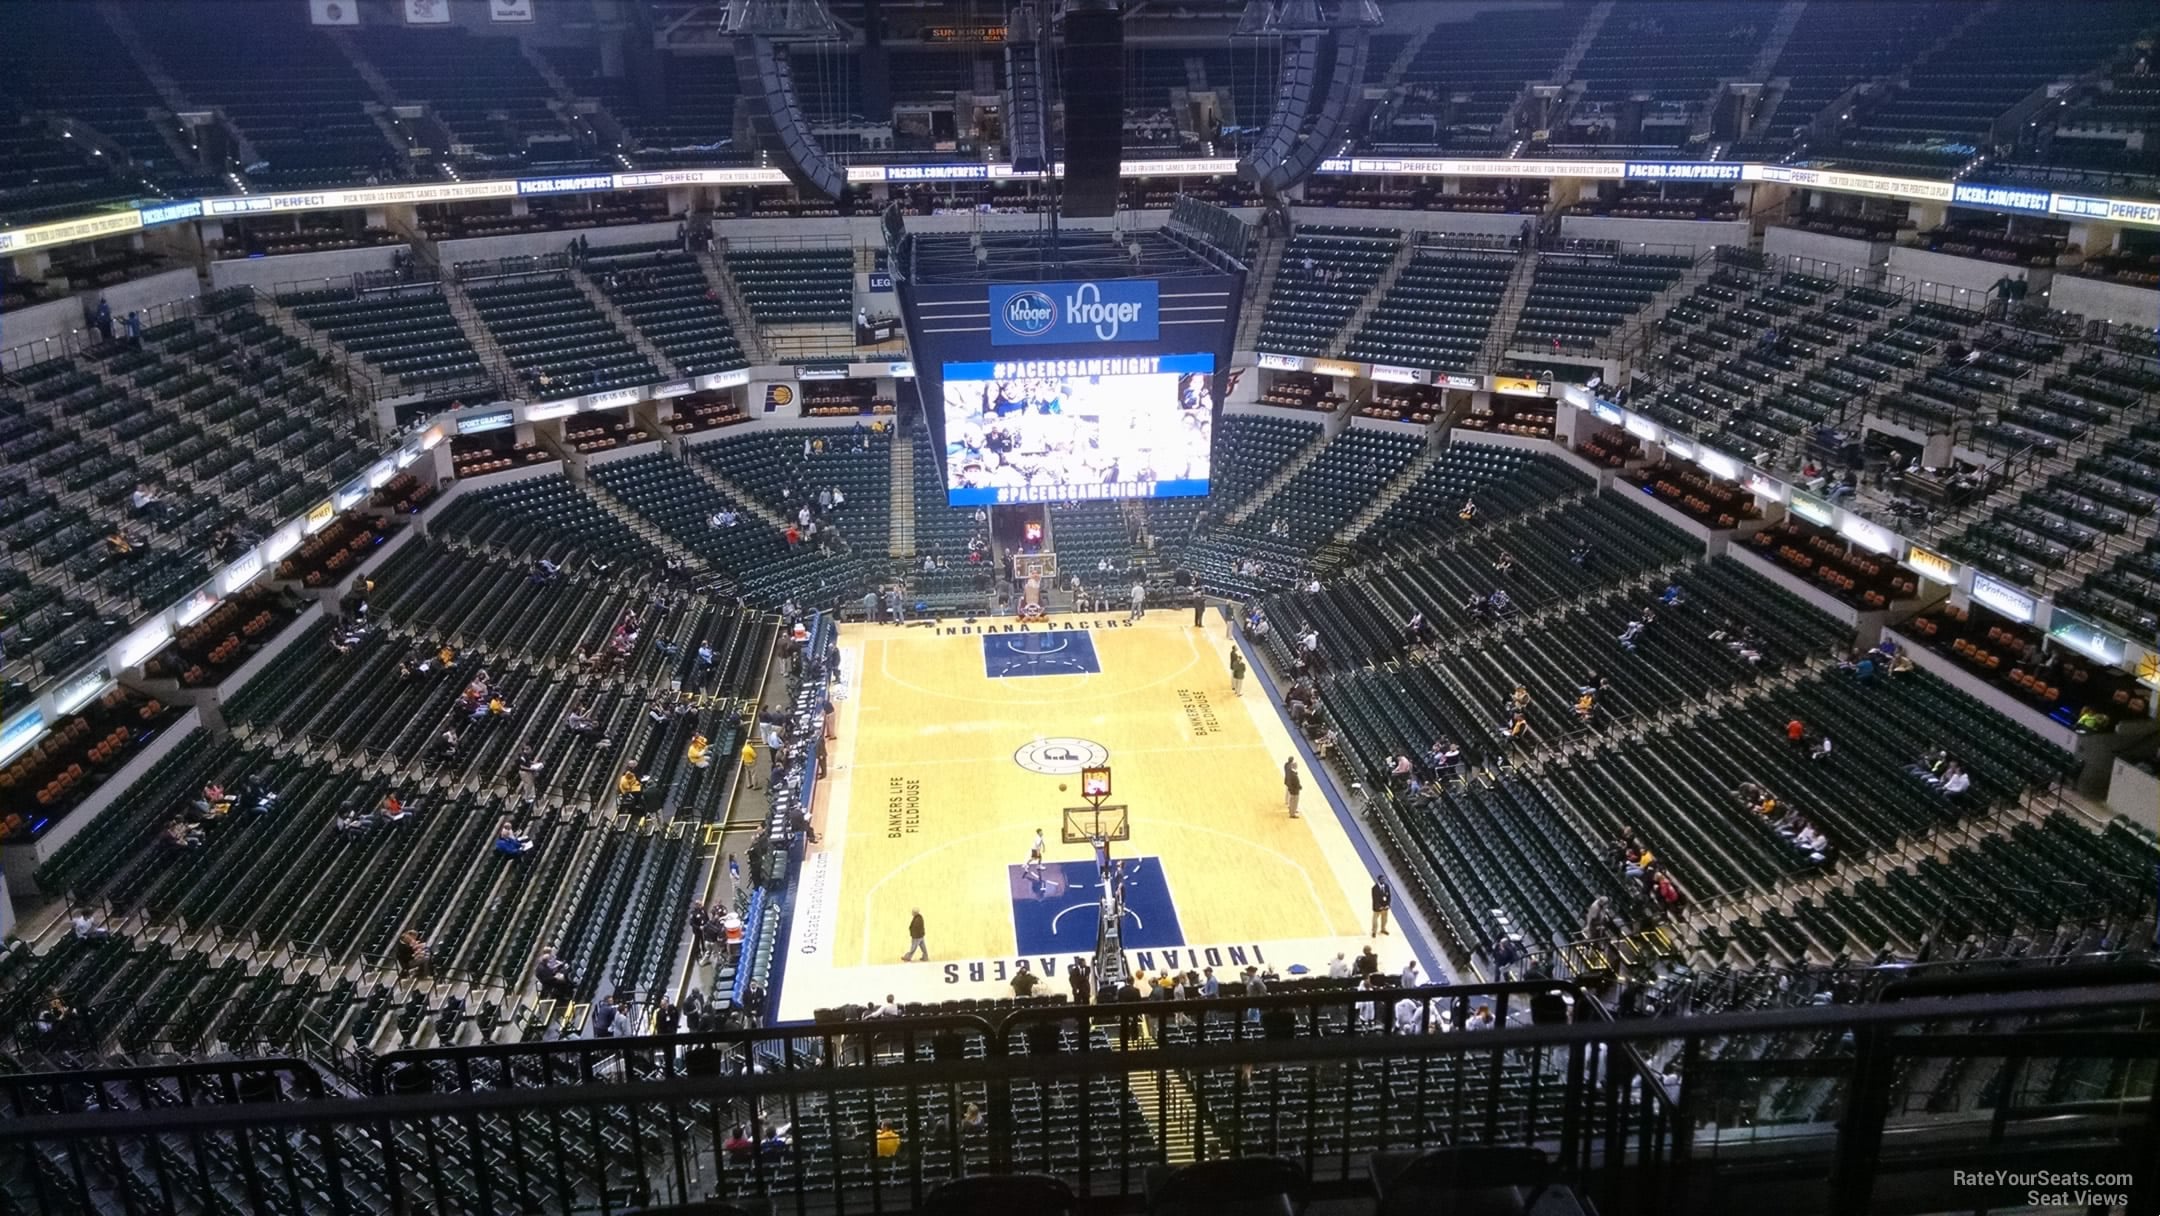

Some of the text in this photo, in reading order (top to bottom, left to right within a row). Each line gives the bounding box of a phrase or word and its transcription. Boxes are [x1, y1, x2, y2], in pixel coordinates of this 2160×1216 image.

[1403, 162, 1443, 171] PERFECT
[1629, 164, 1740, 178] PACERS.COM/PERFECT
[274, 195, 325, 208] PERFECT
[1011, 297, 1052, 330] Kroger
[1066, 282, 1142, 341] Kroger
[993, 358, 1160, 379] #PACERSGAMENIGHT
[997, 481, 1158, 503] #PACERSGAMENIGHT
[936, 619, 1133, 636] INDIANA PACERS
[1184, 703, 1208, 736] BANKERS
[1193, 690, 1222, 733] FIELDHOUSE
[888, 776, 903, 839] BANKERS LIFE
[906, 780, 920, 834] FIELDHOUSE
[1136, 945, 1266, 972] INDIAN
